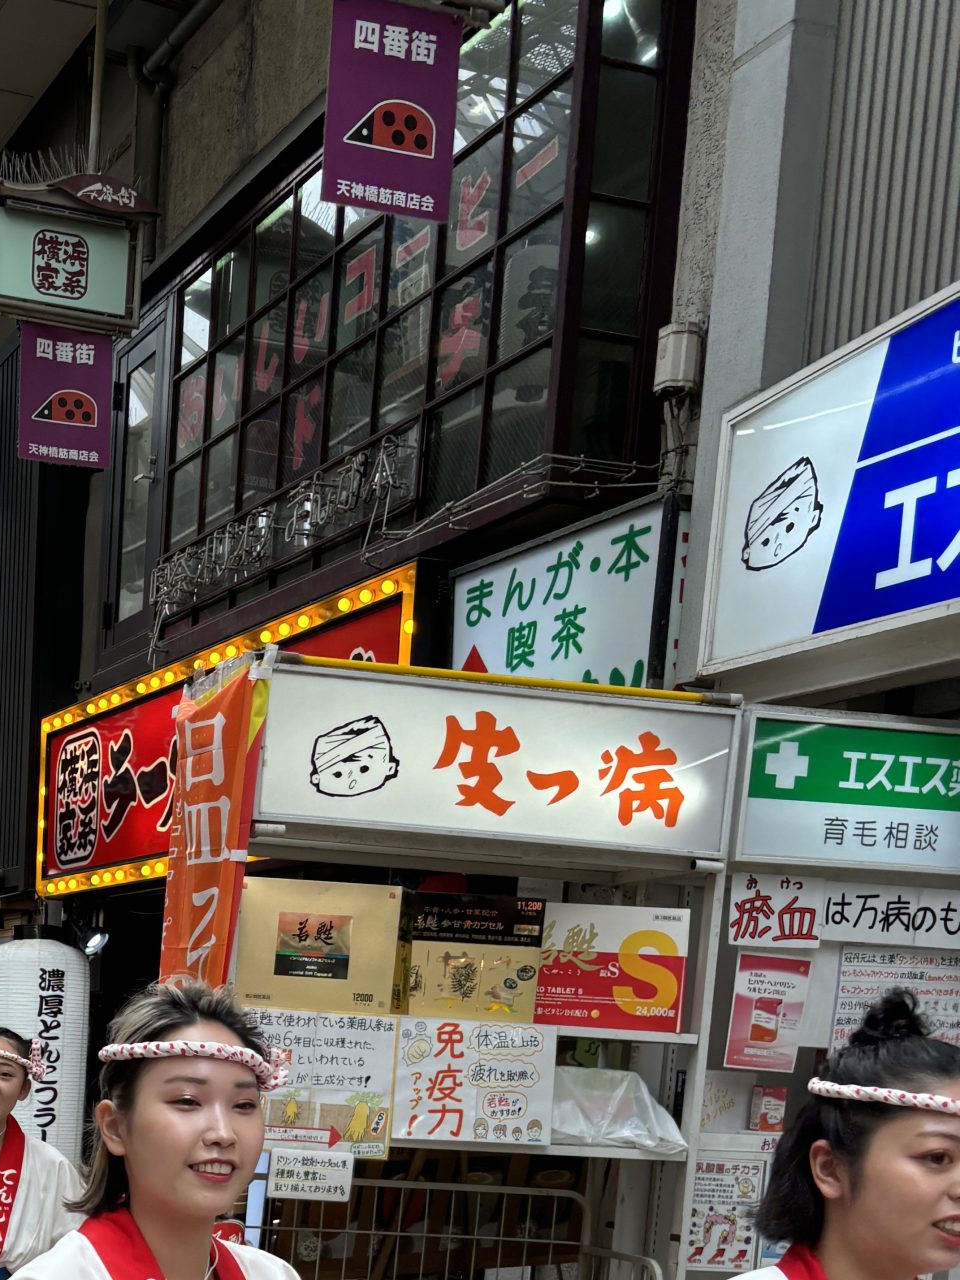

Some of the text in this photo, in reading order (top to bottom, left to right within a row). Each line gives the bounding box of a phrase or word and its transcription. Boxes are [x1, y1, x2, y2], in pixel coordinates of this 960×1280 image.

[354, 19, 437, 65] 四番街
[337, 179, 435, 212] 天神橋筋商店会
[33, 233, 87, 267] 横浜
[35, 264, 85, 296] 家系
[35, 337, 95, 366] 四番街
[28, 443, 99, 463] 天神橋筋商店会
[466, 523, 652, 627] まんが・本
[505, 604, 587, 672] 喫茶
[102, 729, 177, 842] ラー
[823, 816, 940, 852] 育毛相談
[612, 929, 680, 1017] S
[352, 992, 374, 1003] 12000
[547, 986, 576, 995] TABLET
[297, 1053, 365, 1067] といわれている
[425, 1022, 465, 1138] 免疫力
[275, 1168, 327, 1181] 種類も豊富に
[695, 1162, 761, 1177] 乳酸菌のチカラ
